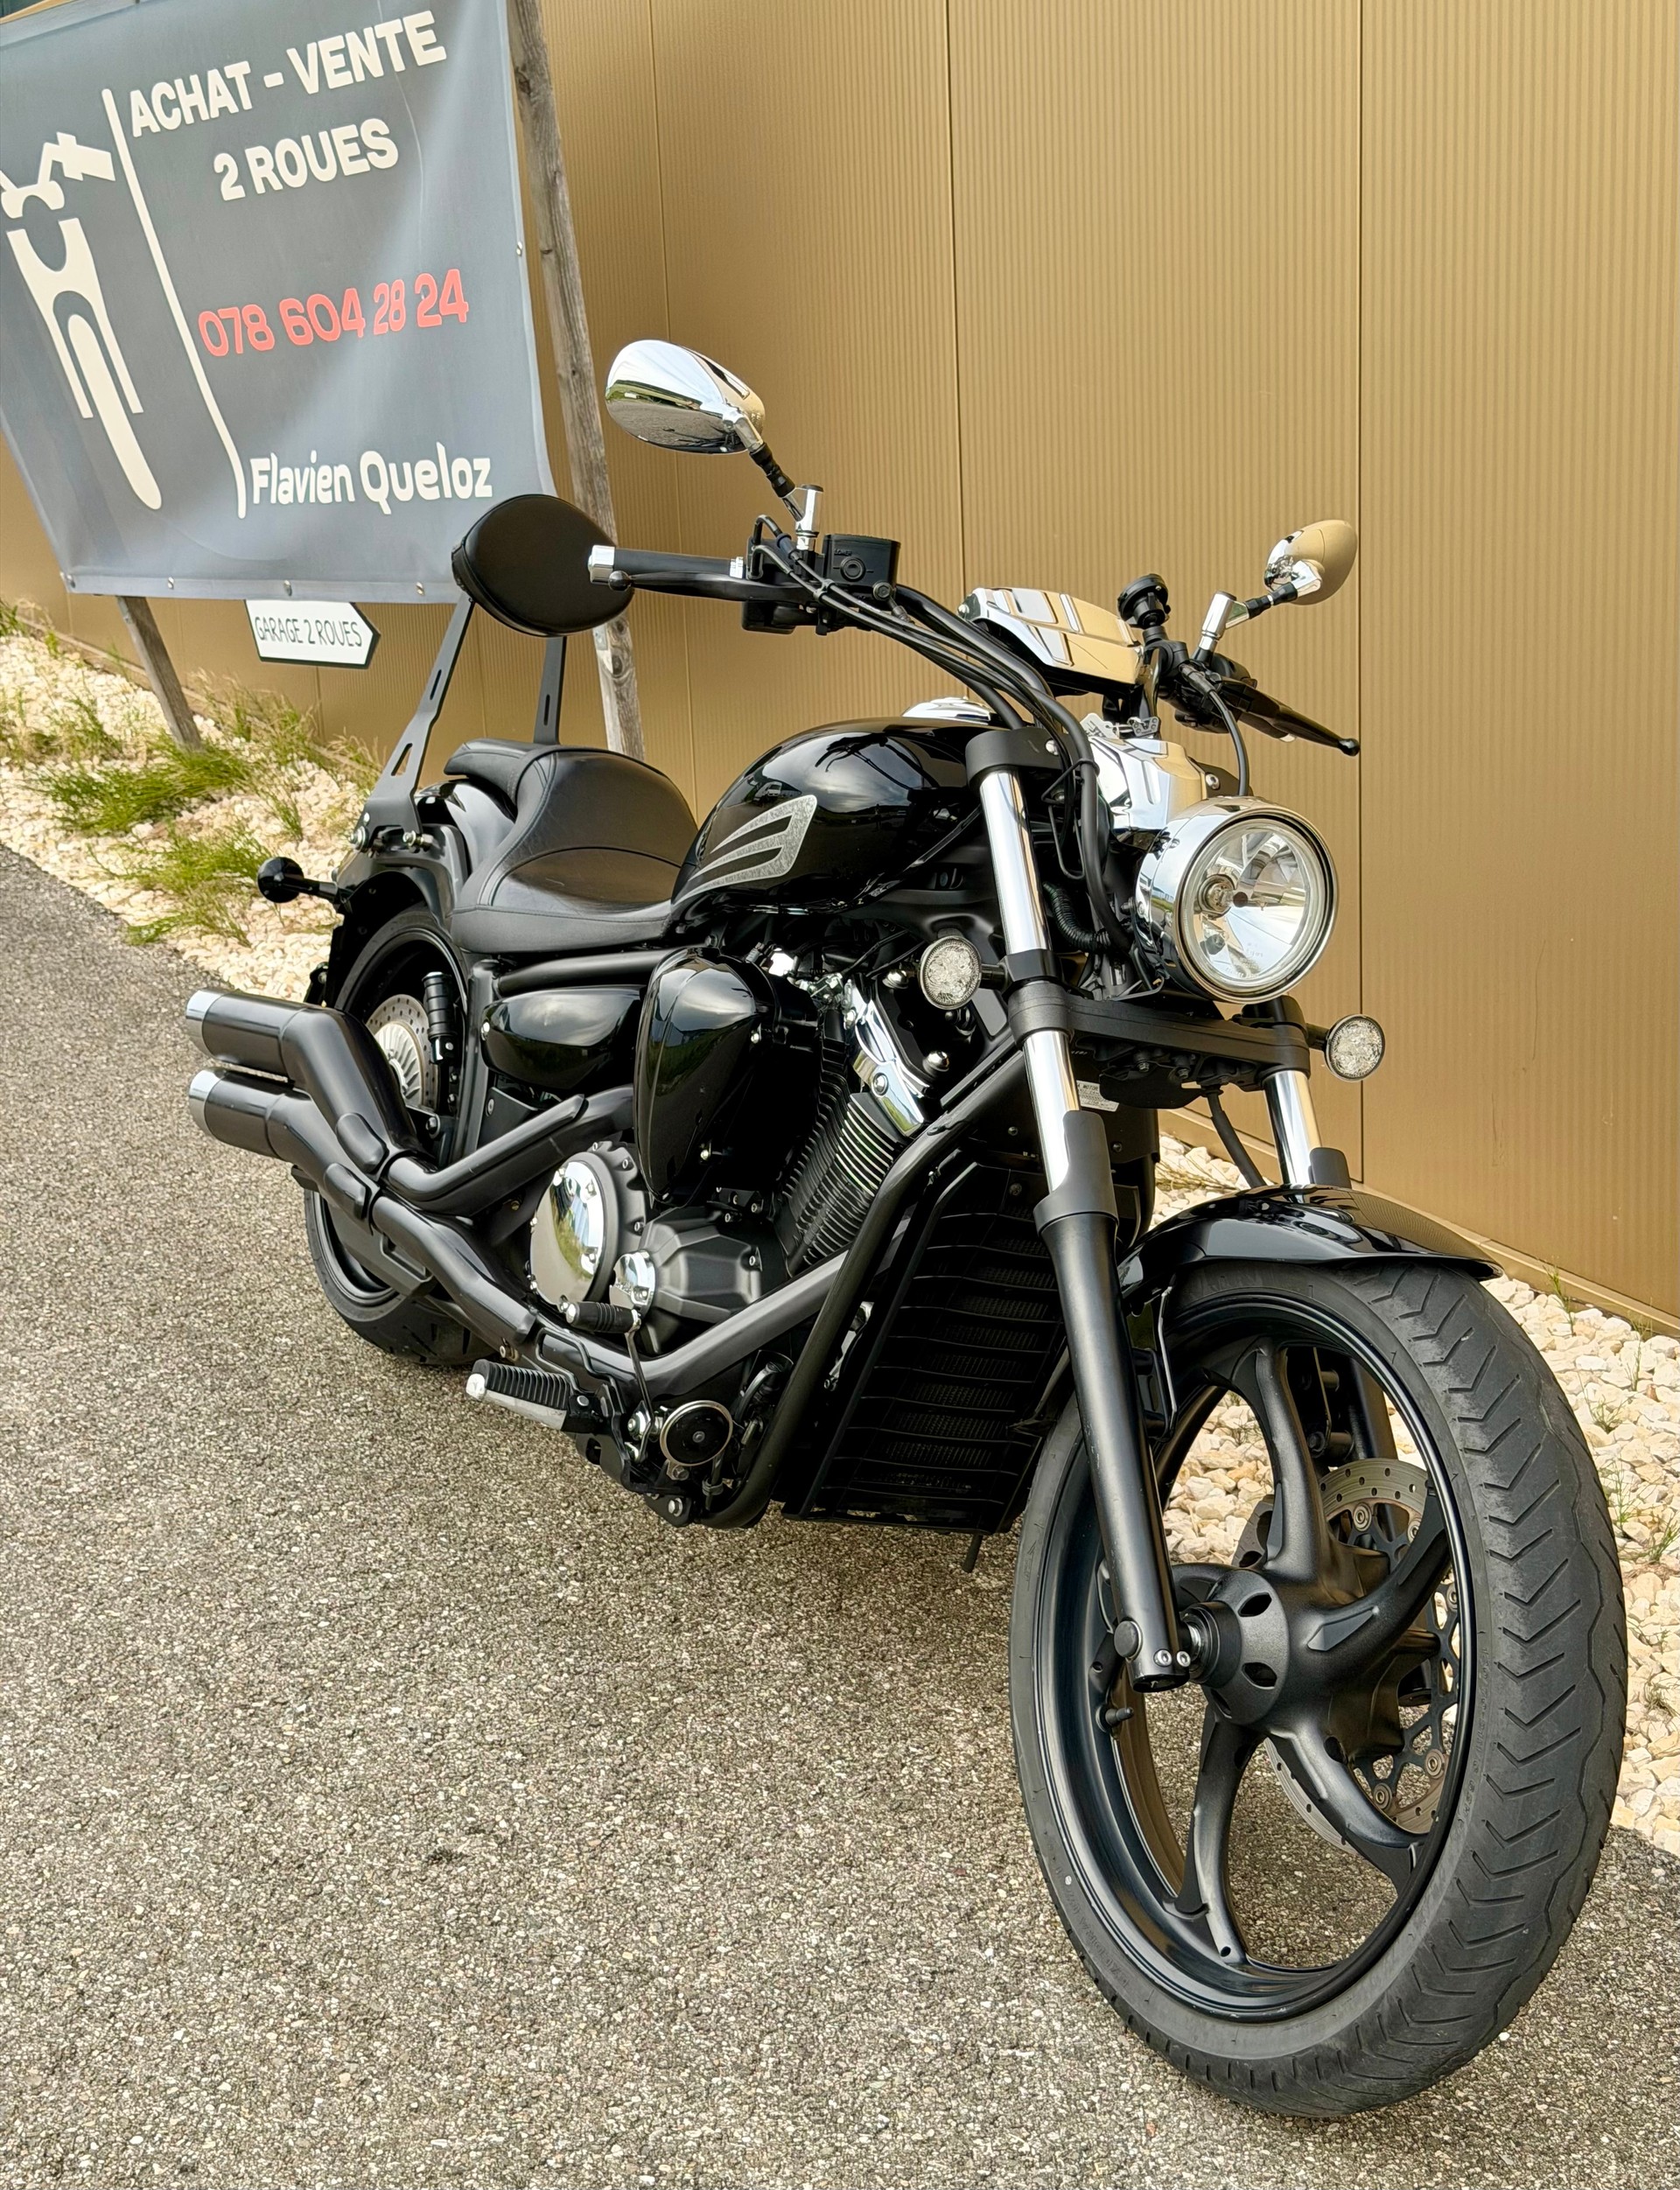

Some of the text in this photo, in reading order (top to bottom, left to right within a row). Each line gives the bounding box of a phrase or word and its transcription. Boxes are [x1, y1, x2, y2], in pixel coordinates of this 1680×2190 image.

[130, 10, 447, 137] ACHAT - VENTE
[214, 117, 399, 201] 2 ROUES
[198, 268, 470, 357] 078 604 28 24
[250, 441, 494, 515] Flavien Queloz
[255, 616, 362, 647] GARAGE 2 ROUES
